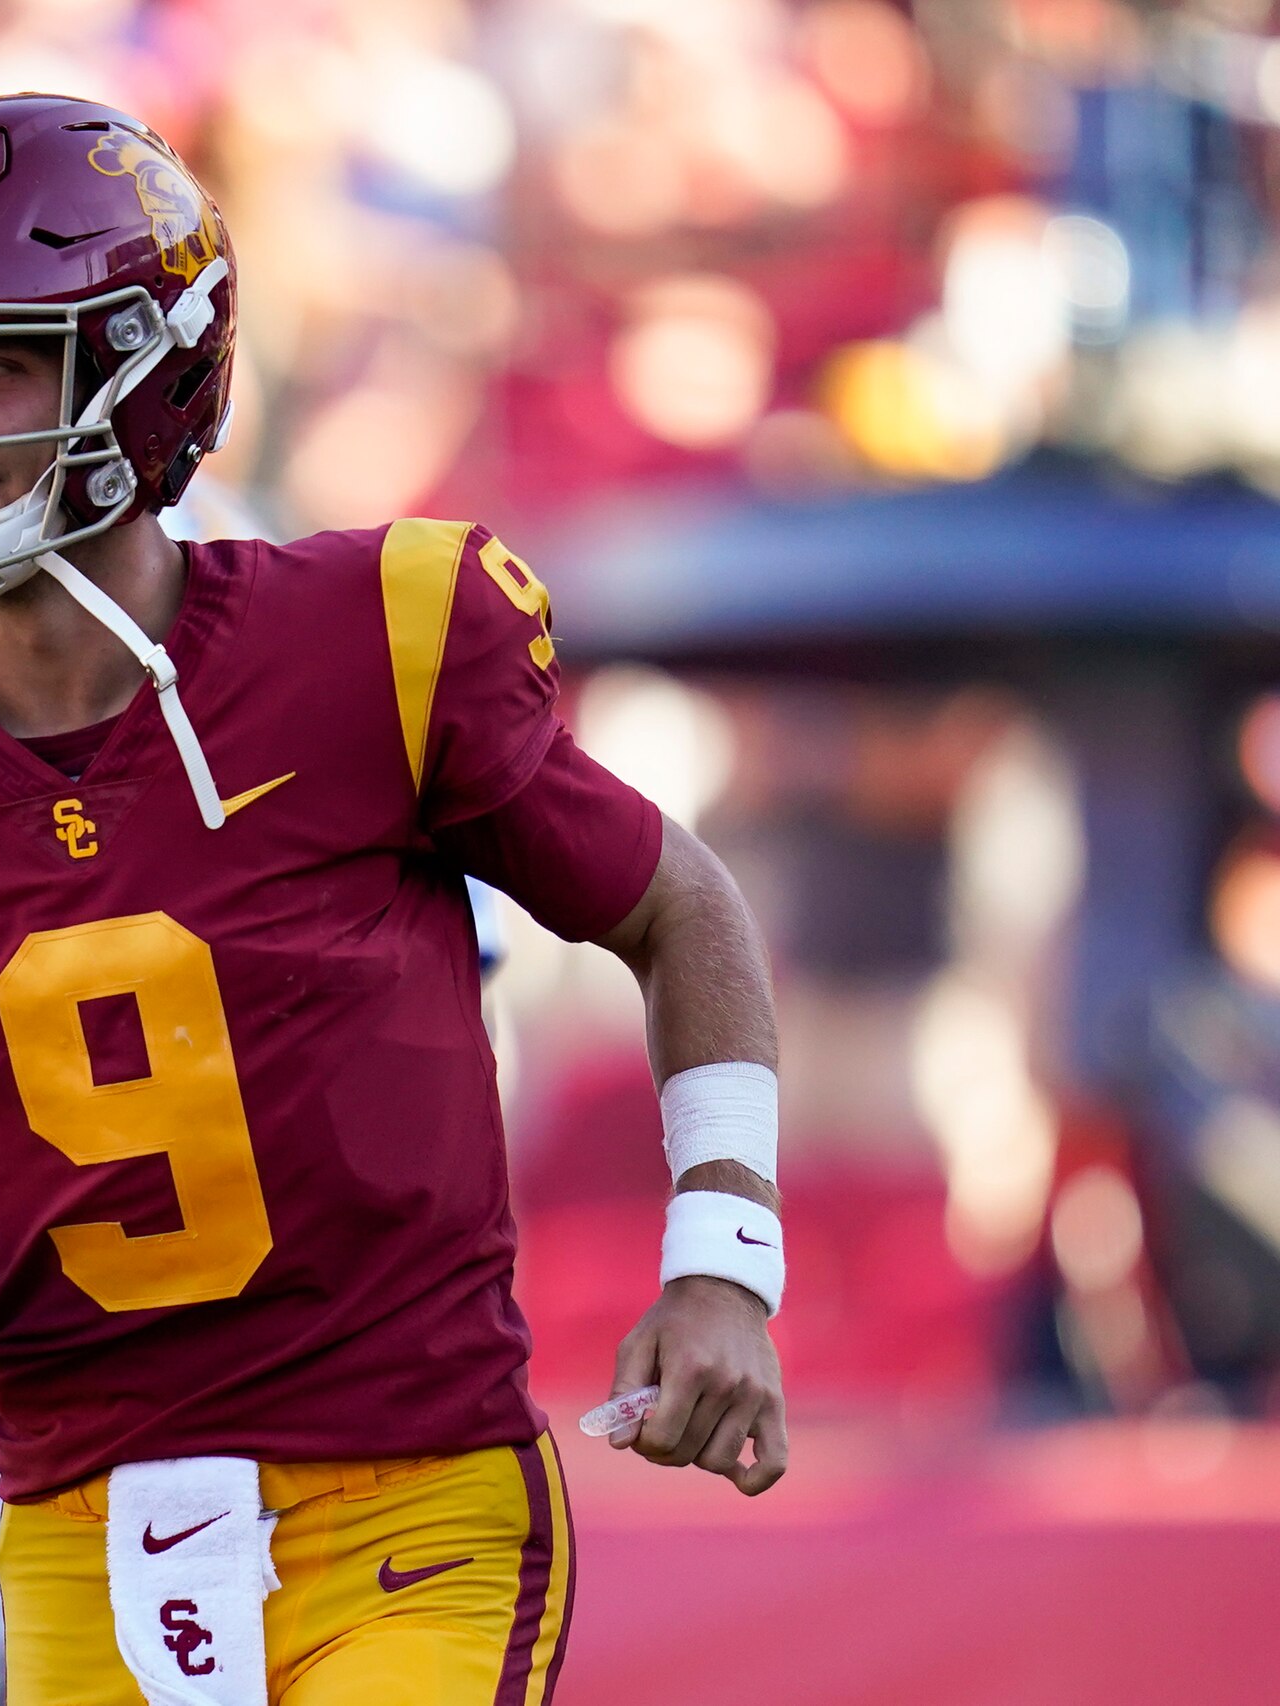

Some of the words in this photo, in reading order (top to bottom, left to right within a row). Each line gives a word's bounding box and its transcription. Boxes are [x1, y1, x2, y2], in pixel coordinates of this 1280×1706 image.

[478, 536, 555, 671] 9
[53, 798, 98, 859] SC
[160, 1599, 215, 1676] SC
